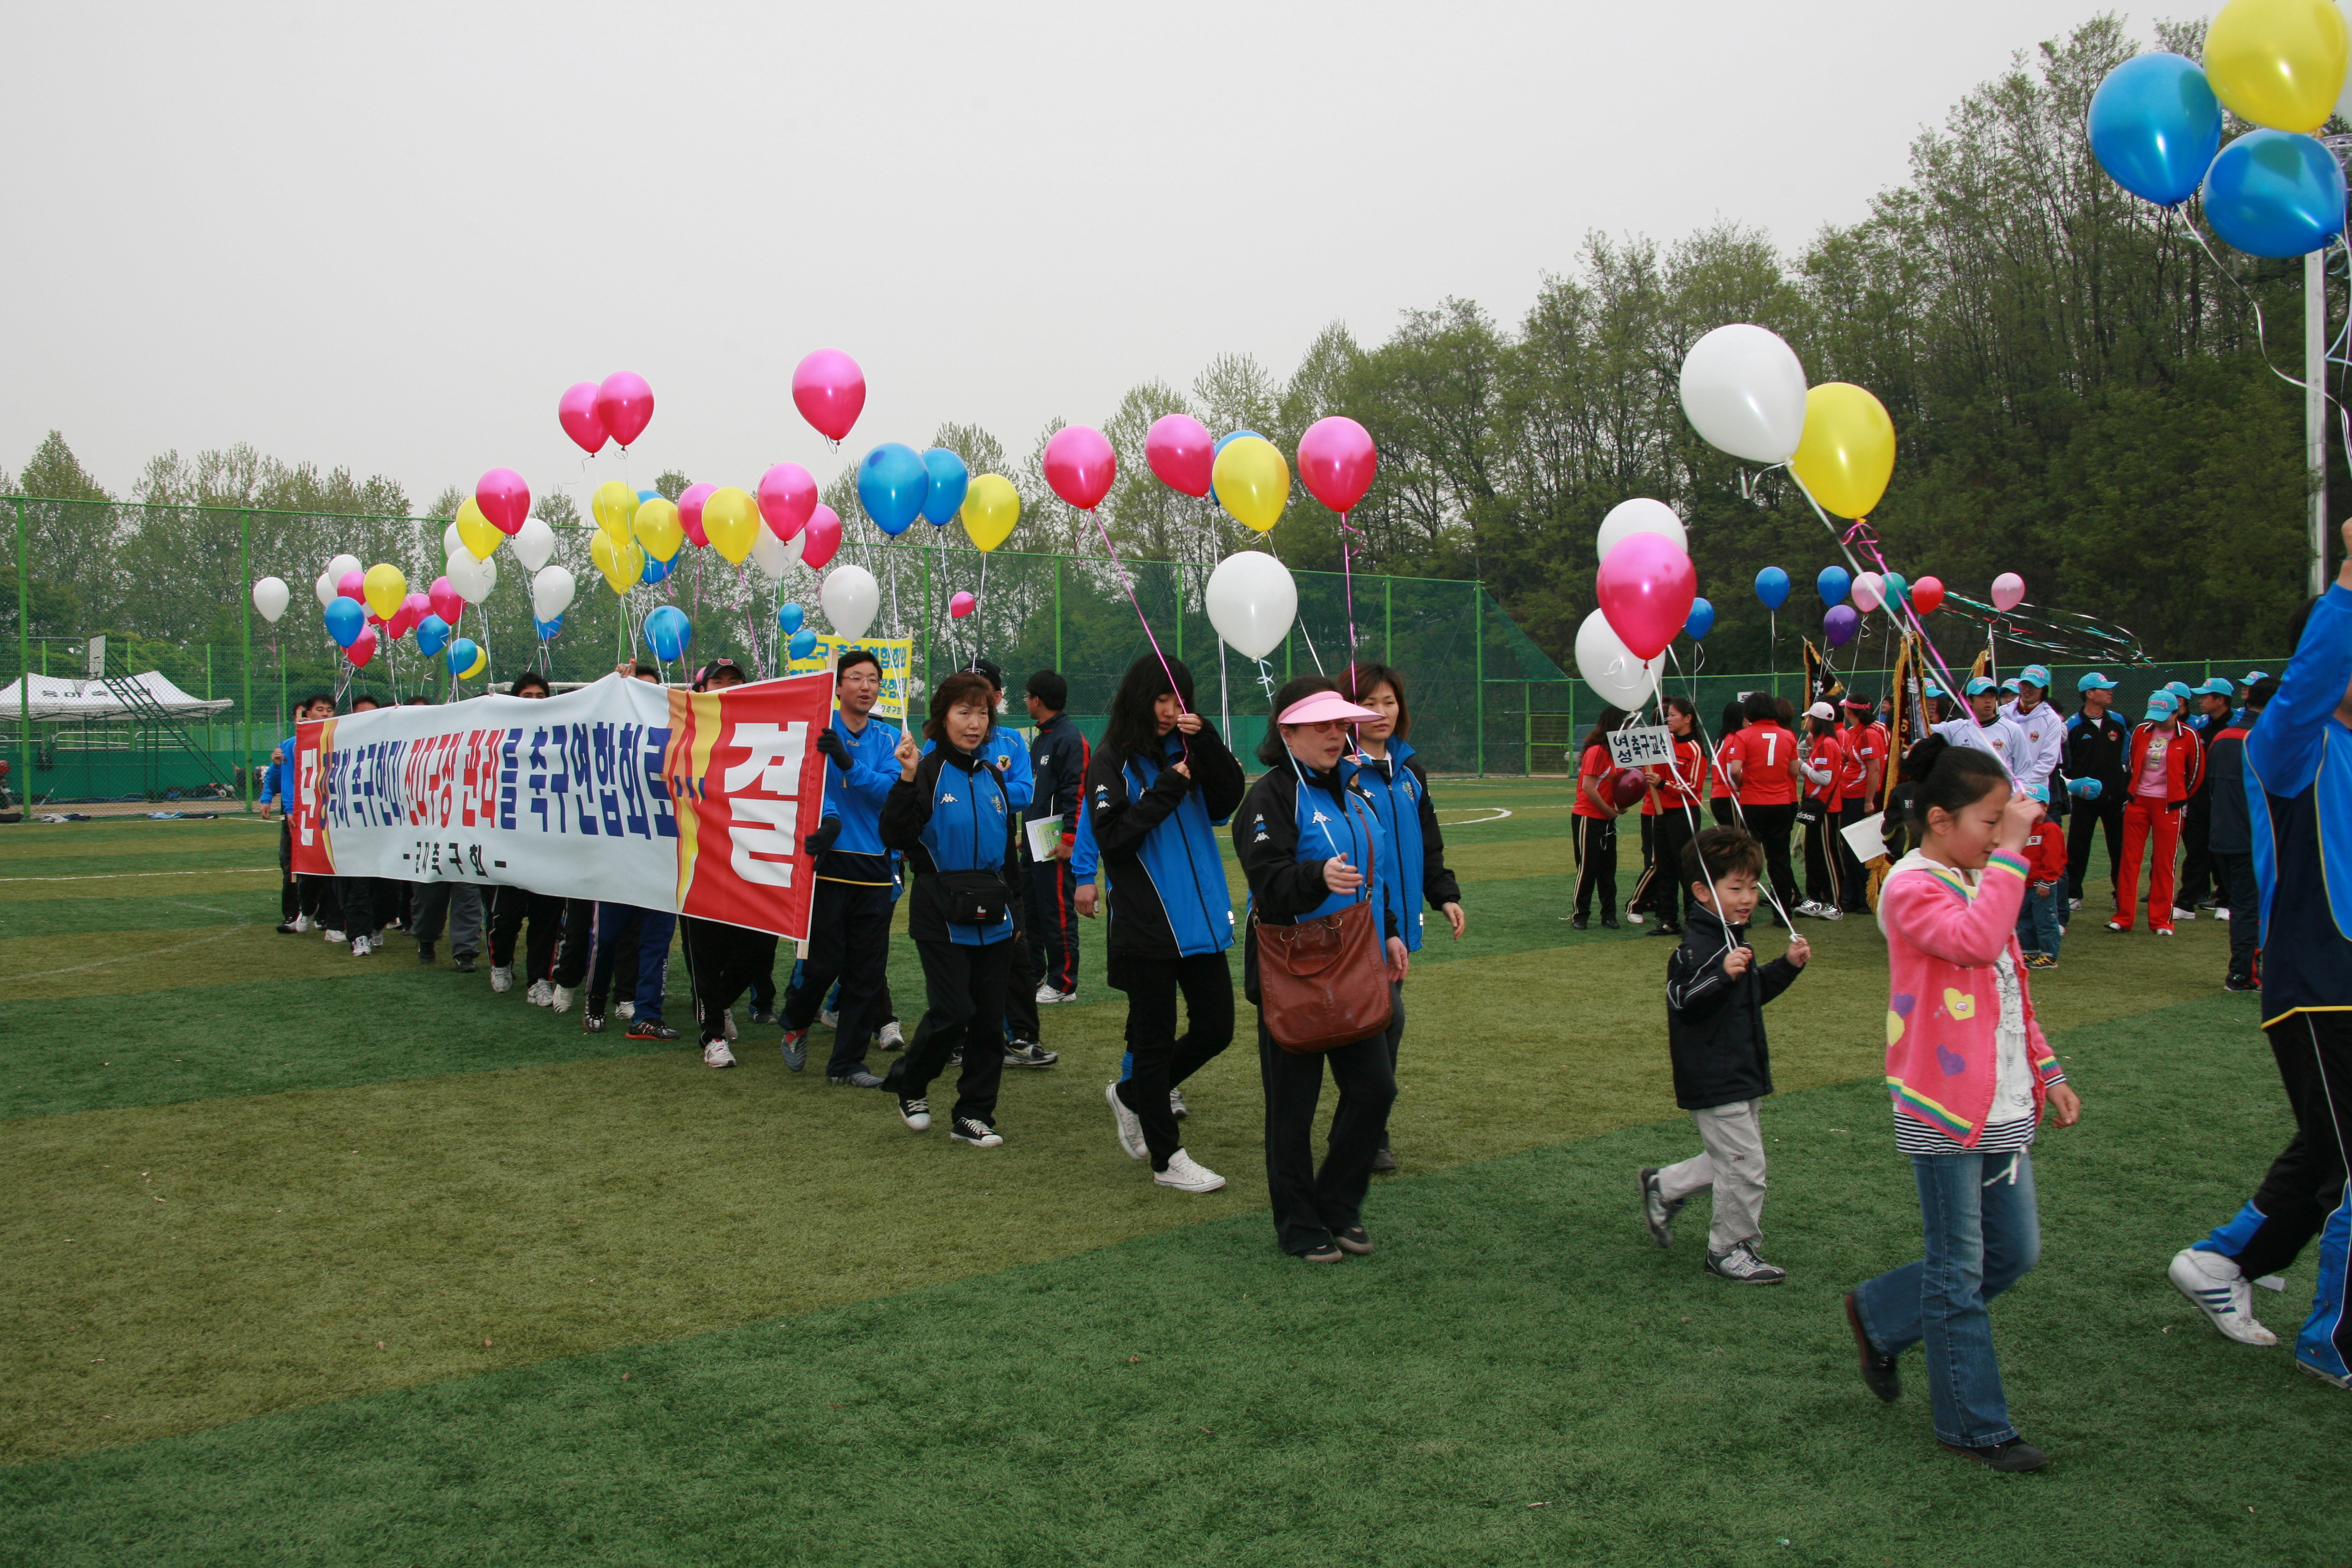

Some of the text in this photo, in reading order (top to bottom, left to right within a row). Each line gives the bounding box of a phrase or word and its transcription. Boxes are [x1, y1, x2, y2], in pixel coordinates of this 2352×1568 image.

[300, 748, 318, 846] 단
[404, 731, 464, 828] 잔디구장
[462, 728, 523, 830] 관리를
[1761, 733, 1777, 766] 7
[724, 721, 809, 888] 결
